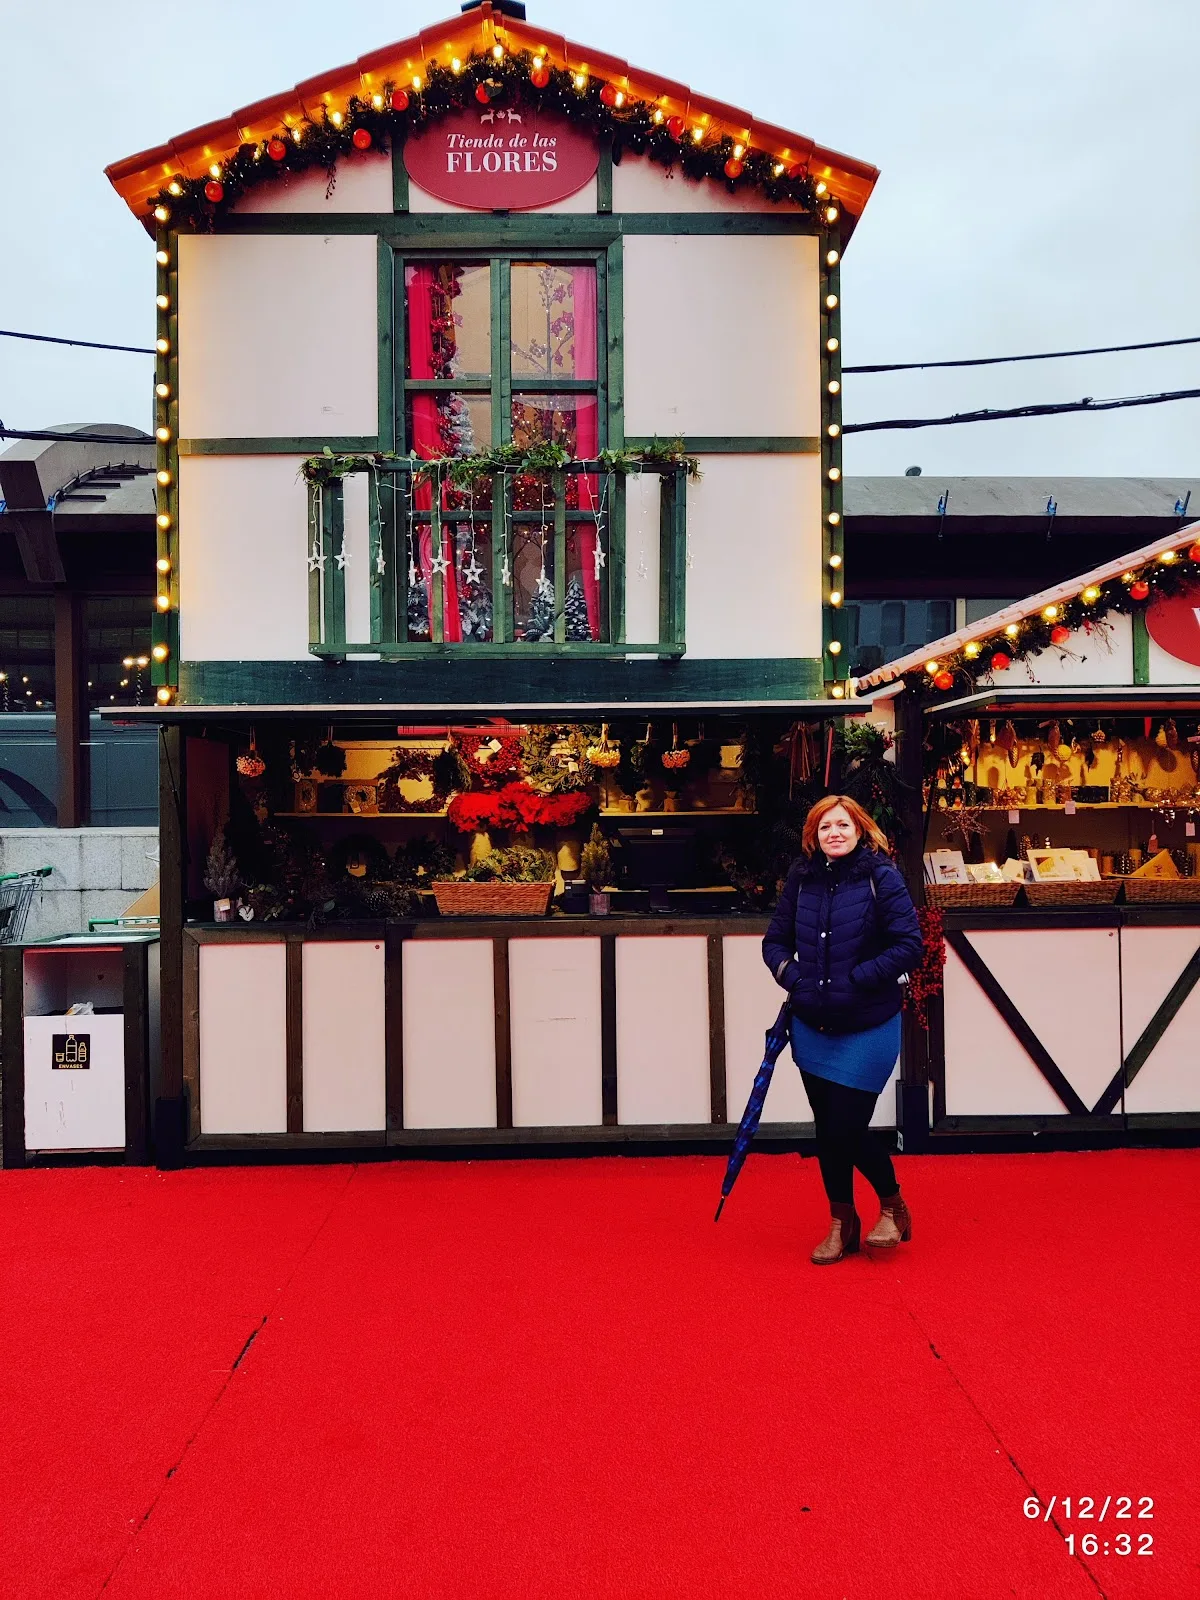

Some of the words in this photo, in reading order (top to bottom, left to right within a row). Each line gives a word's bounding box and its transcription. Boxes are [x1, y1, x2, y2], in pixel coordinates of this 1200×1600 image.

[447, 133, 504, 148] Tienda
[509, 133, 528, 148] de
[533, 133, 557, 148] las
[446, 151, 558, 173] FLORES
